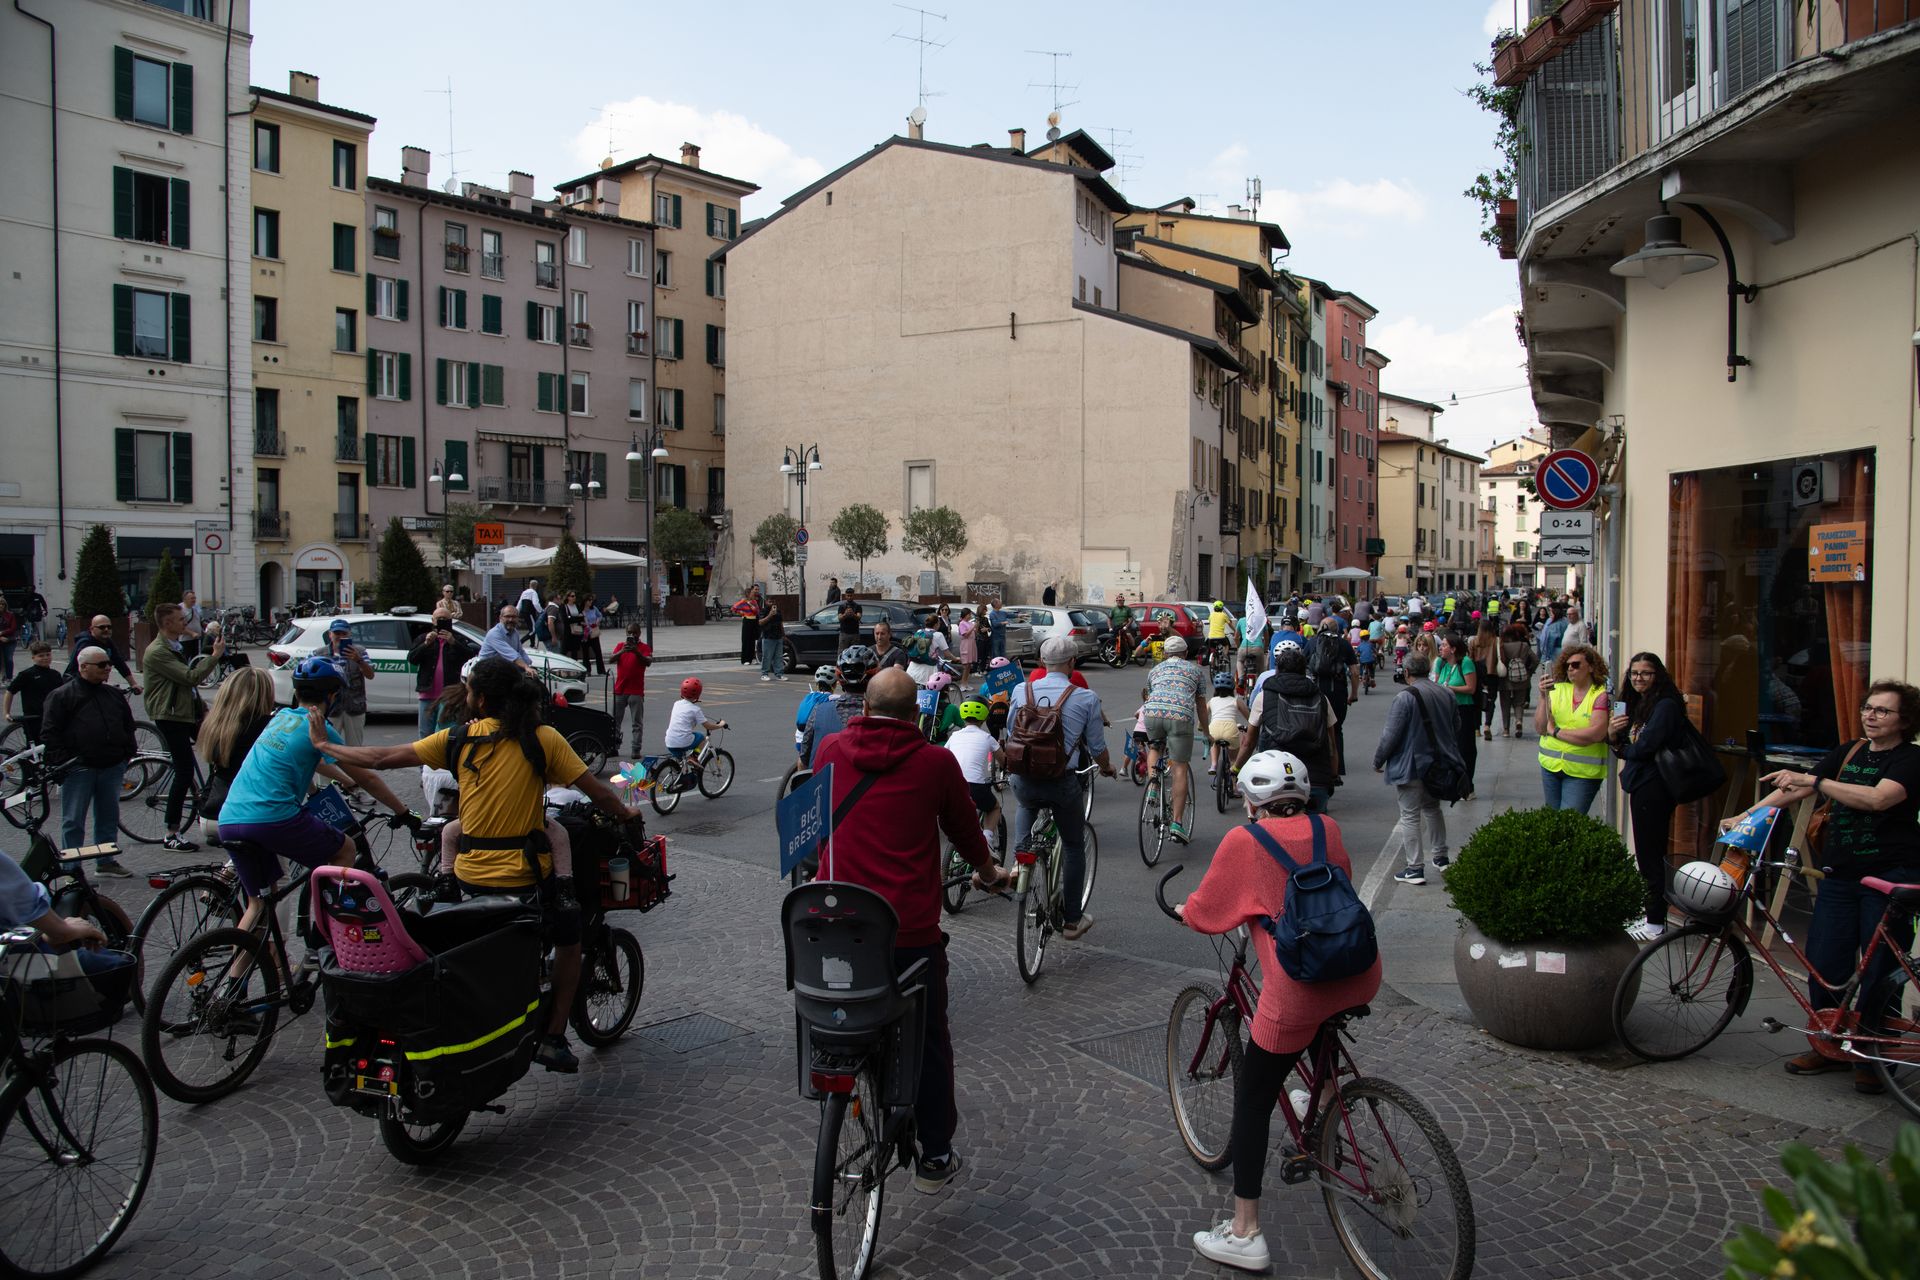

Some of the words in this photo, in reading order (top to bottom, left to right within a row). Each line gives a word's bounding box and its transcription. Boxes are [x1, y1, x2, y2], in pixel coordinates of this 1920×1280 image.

[1552, 519, 1582, 528] 0-24
[478, 528, 502, 539] TAXI
[1824, 542, 1848, 551] PANINI
[371, 662, 406, 672] OLIZIA
